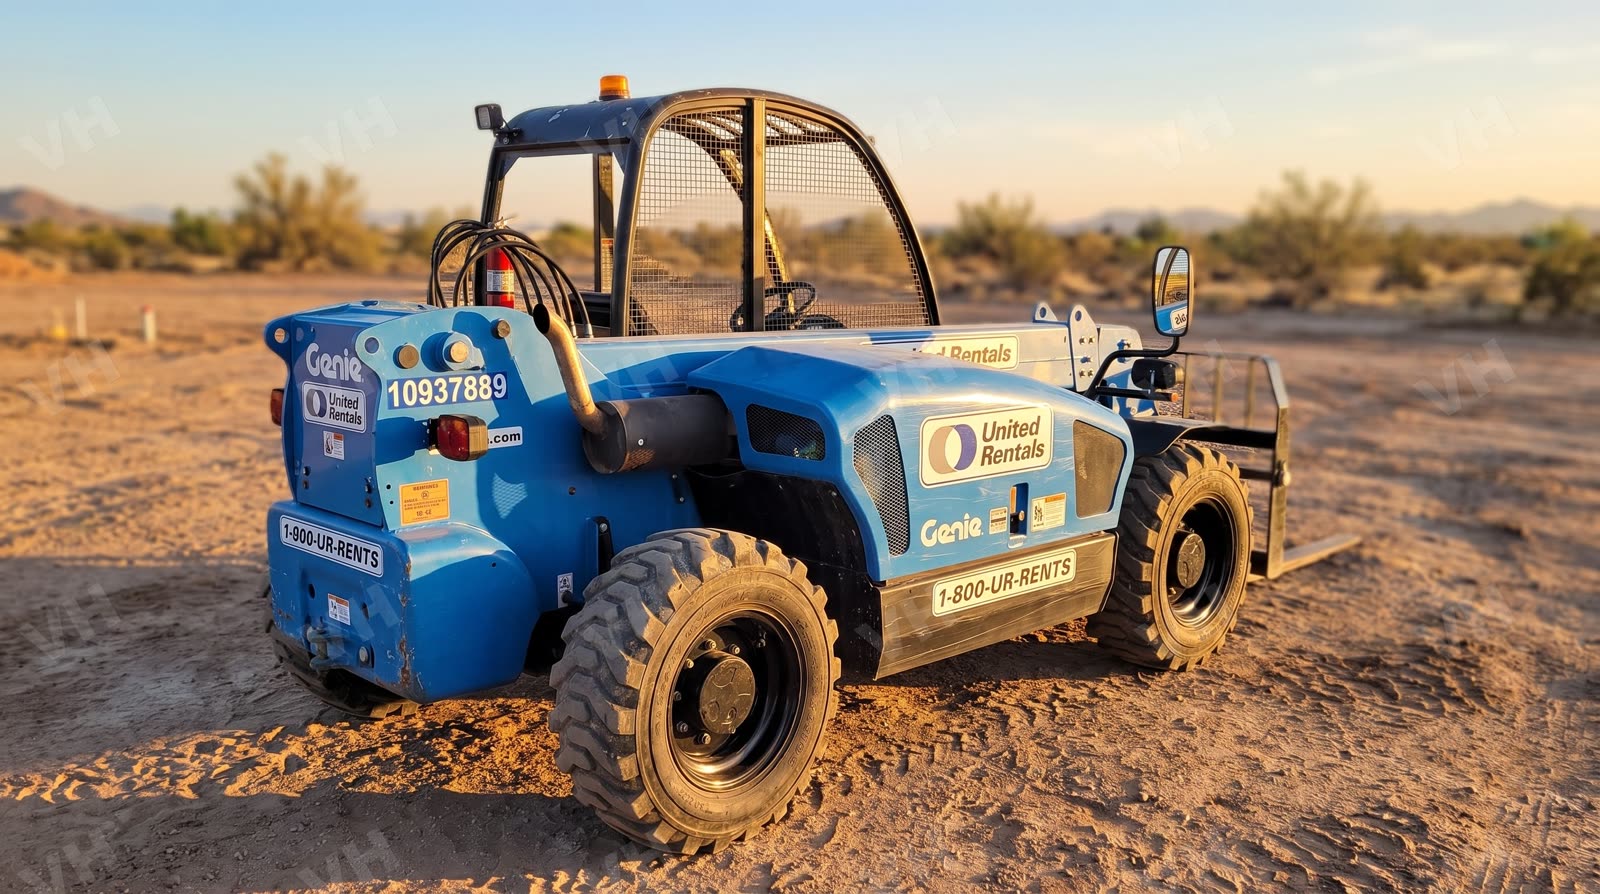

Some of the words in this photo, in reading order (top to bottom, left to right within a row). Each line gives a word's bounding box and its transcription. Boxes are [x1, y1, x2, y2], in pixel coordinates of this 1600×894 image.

[306, 342, 363, 383] Genie
[950, 344, 1012, 363] Rentals
[329, 392, 359, 410] United
[388, 373, 508, 408] 10937889
[329, 407, 362, 426] Rentals
[981, 415, 1041, 444] United
[487, 432, 521, 445] .com
[980, 438, 1045, 468] Rentals
[284, 523, 379, 568] 1-900-UR-RENTS
[921, 513, 982, 548] Genie
[938, 557, 1072, 608] 1-800-UR-RENTS
